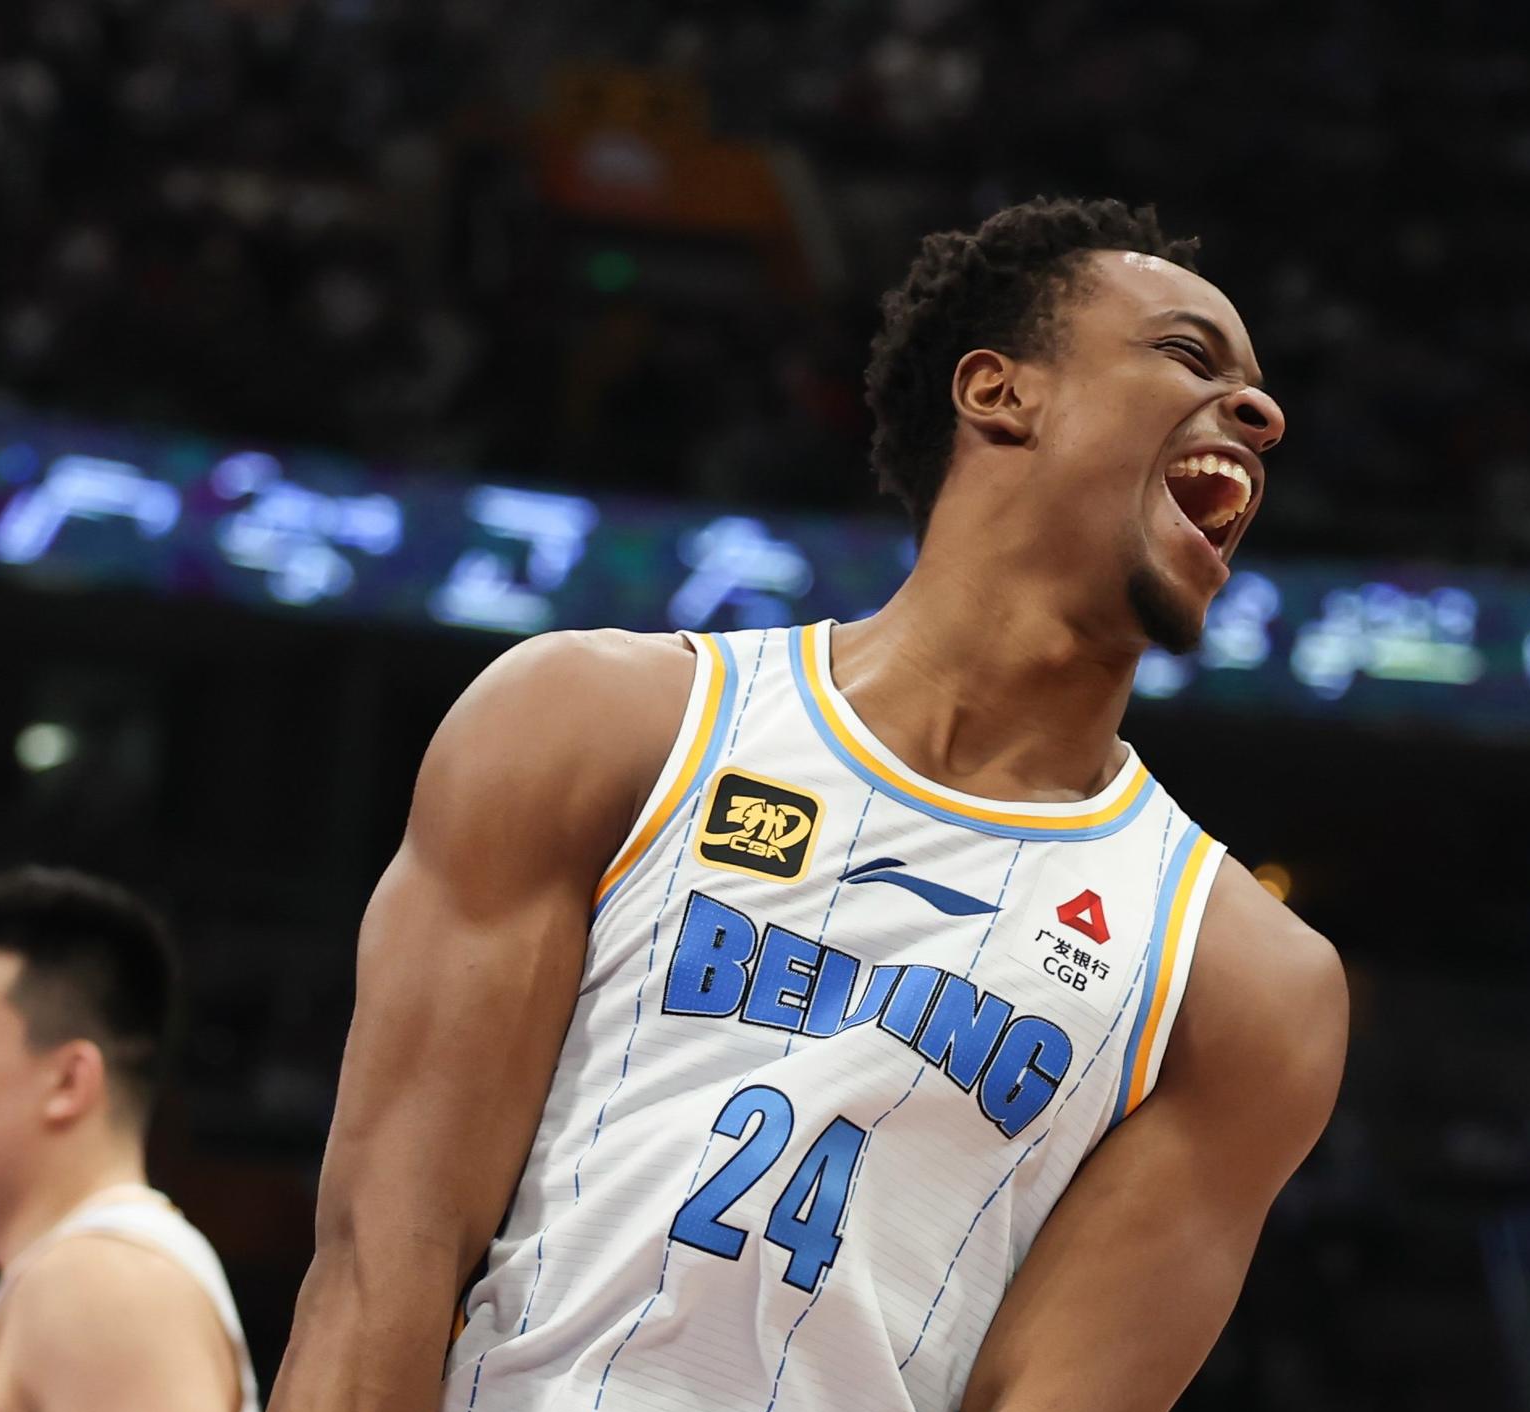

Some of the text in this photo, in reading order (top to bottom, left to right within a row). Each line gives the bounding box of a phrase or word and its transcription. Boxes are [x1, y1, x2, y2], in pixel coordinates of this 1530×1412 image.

[729, 835, 787, 863] CBA
[1034, 928, 1111, 981] 广发银行
[1042, 956, 1088, 992] CGB
[661, 890, 1073, 1140] BEIJING
[668, 1084, 870, 1294] 24
